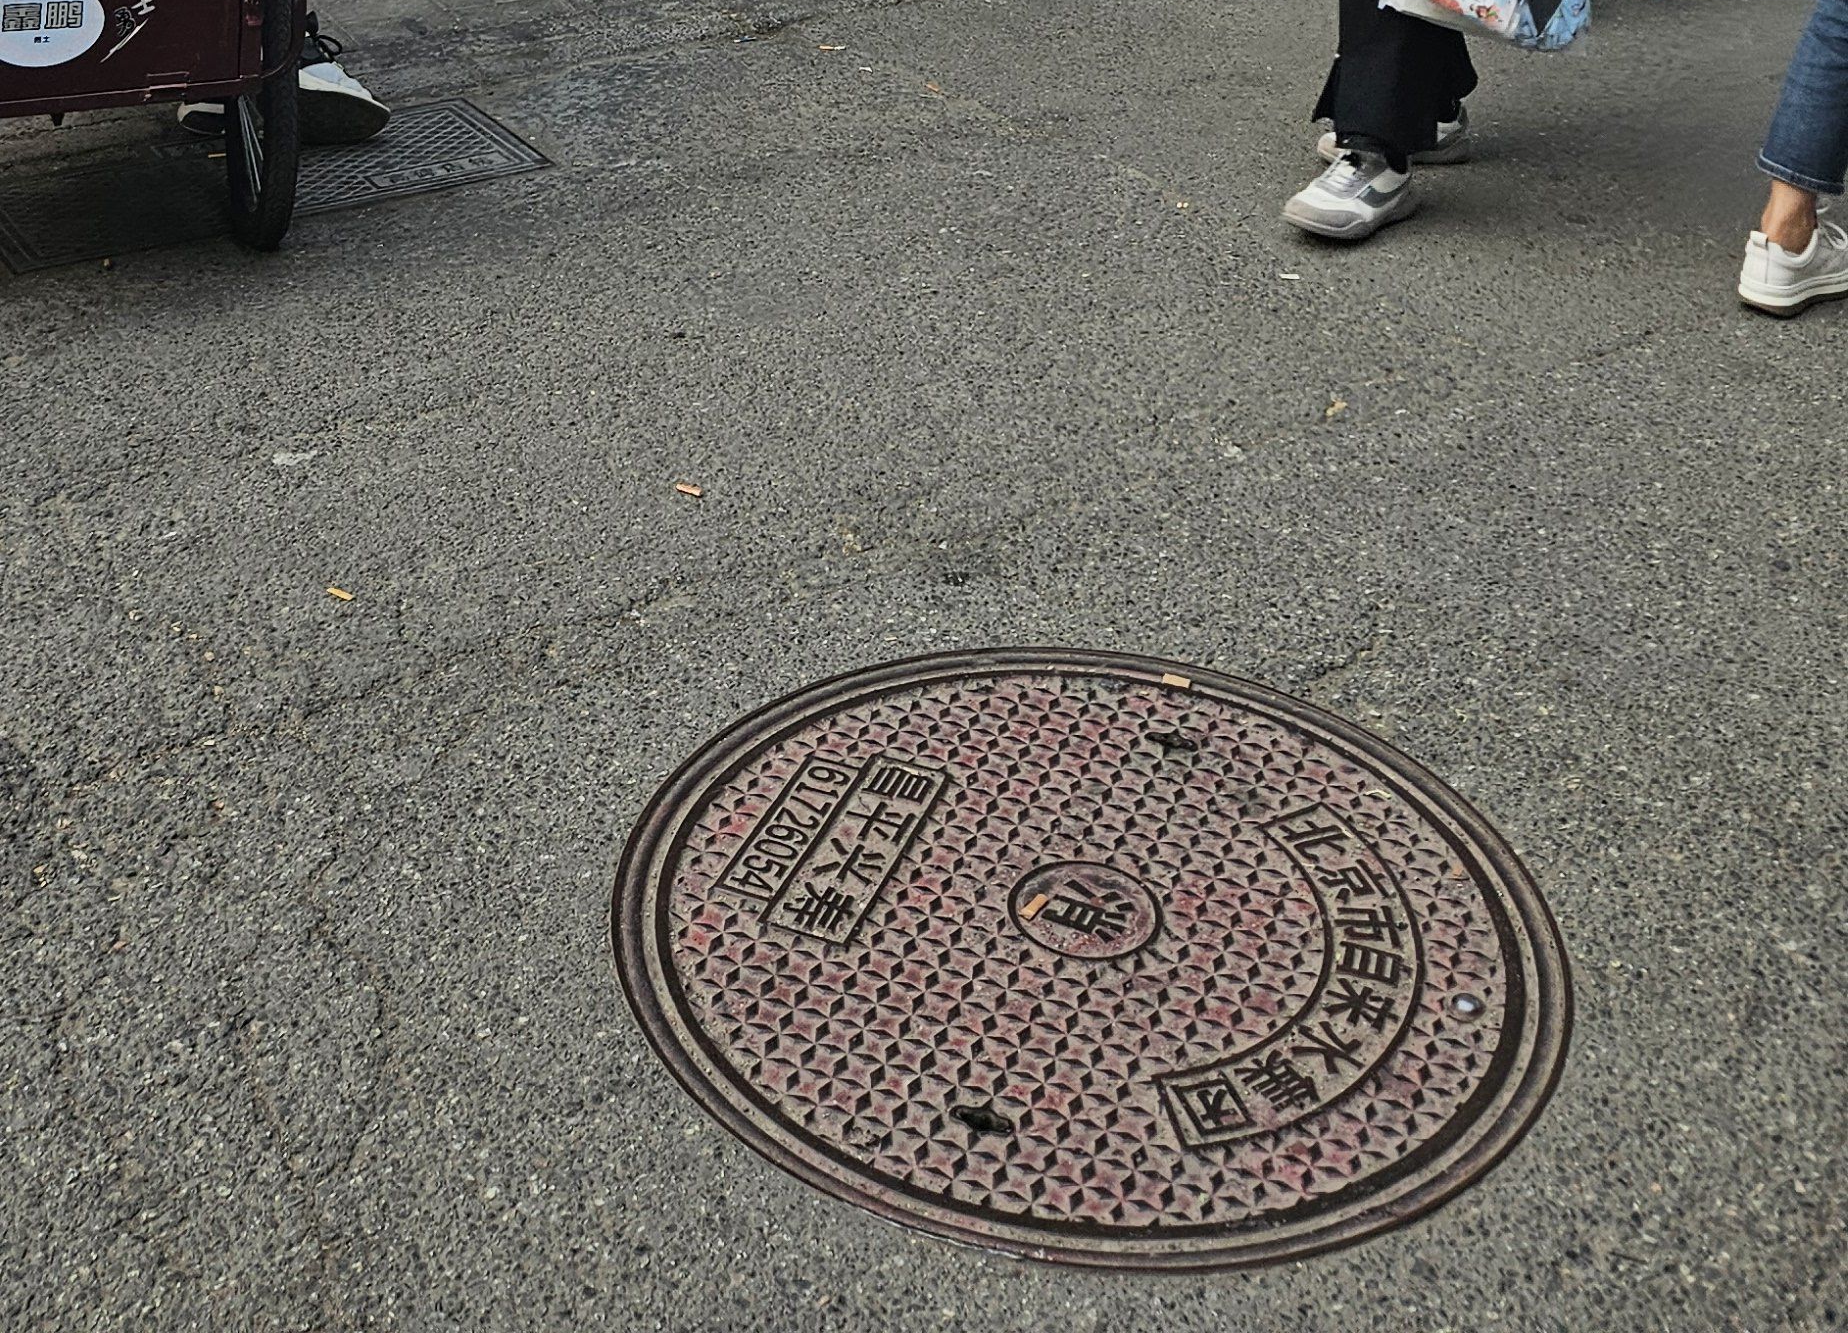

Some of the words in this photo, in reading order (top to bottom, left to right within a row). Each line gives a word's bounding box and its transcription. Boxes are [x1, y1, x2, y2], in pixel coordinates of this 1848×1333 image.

[729, 764, 851, 894] 61726054
[782, 765, 934, 933] 昌平兴寿
[1171, 819, 1415, 1132] 北京市自来水集团
